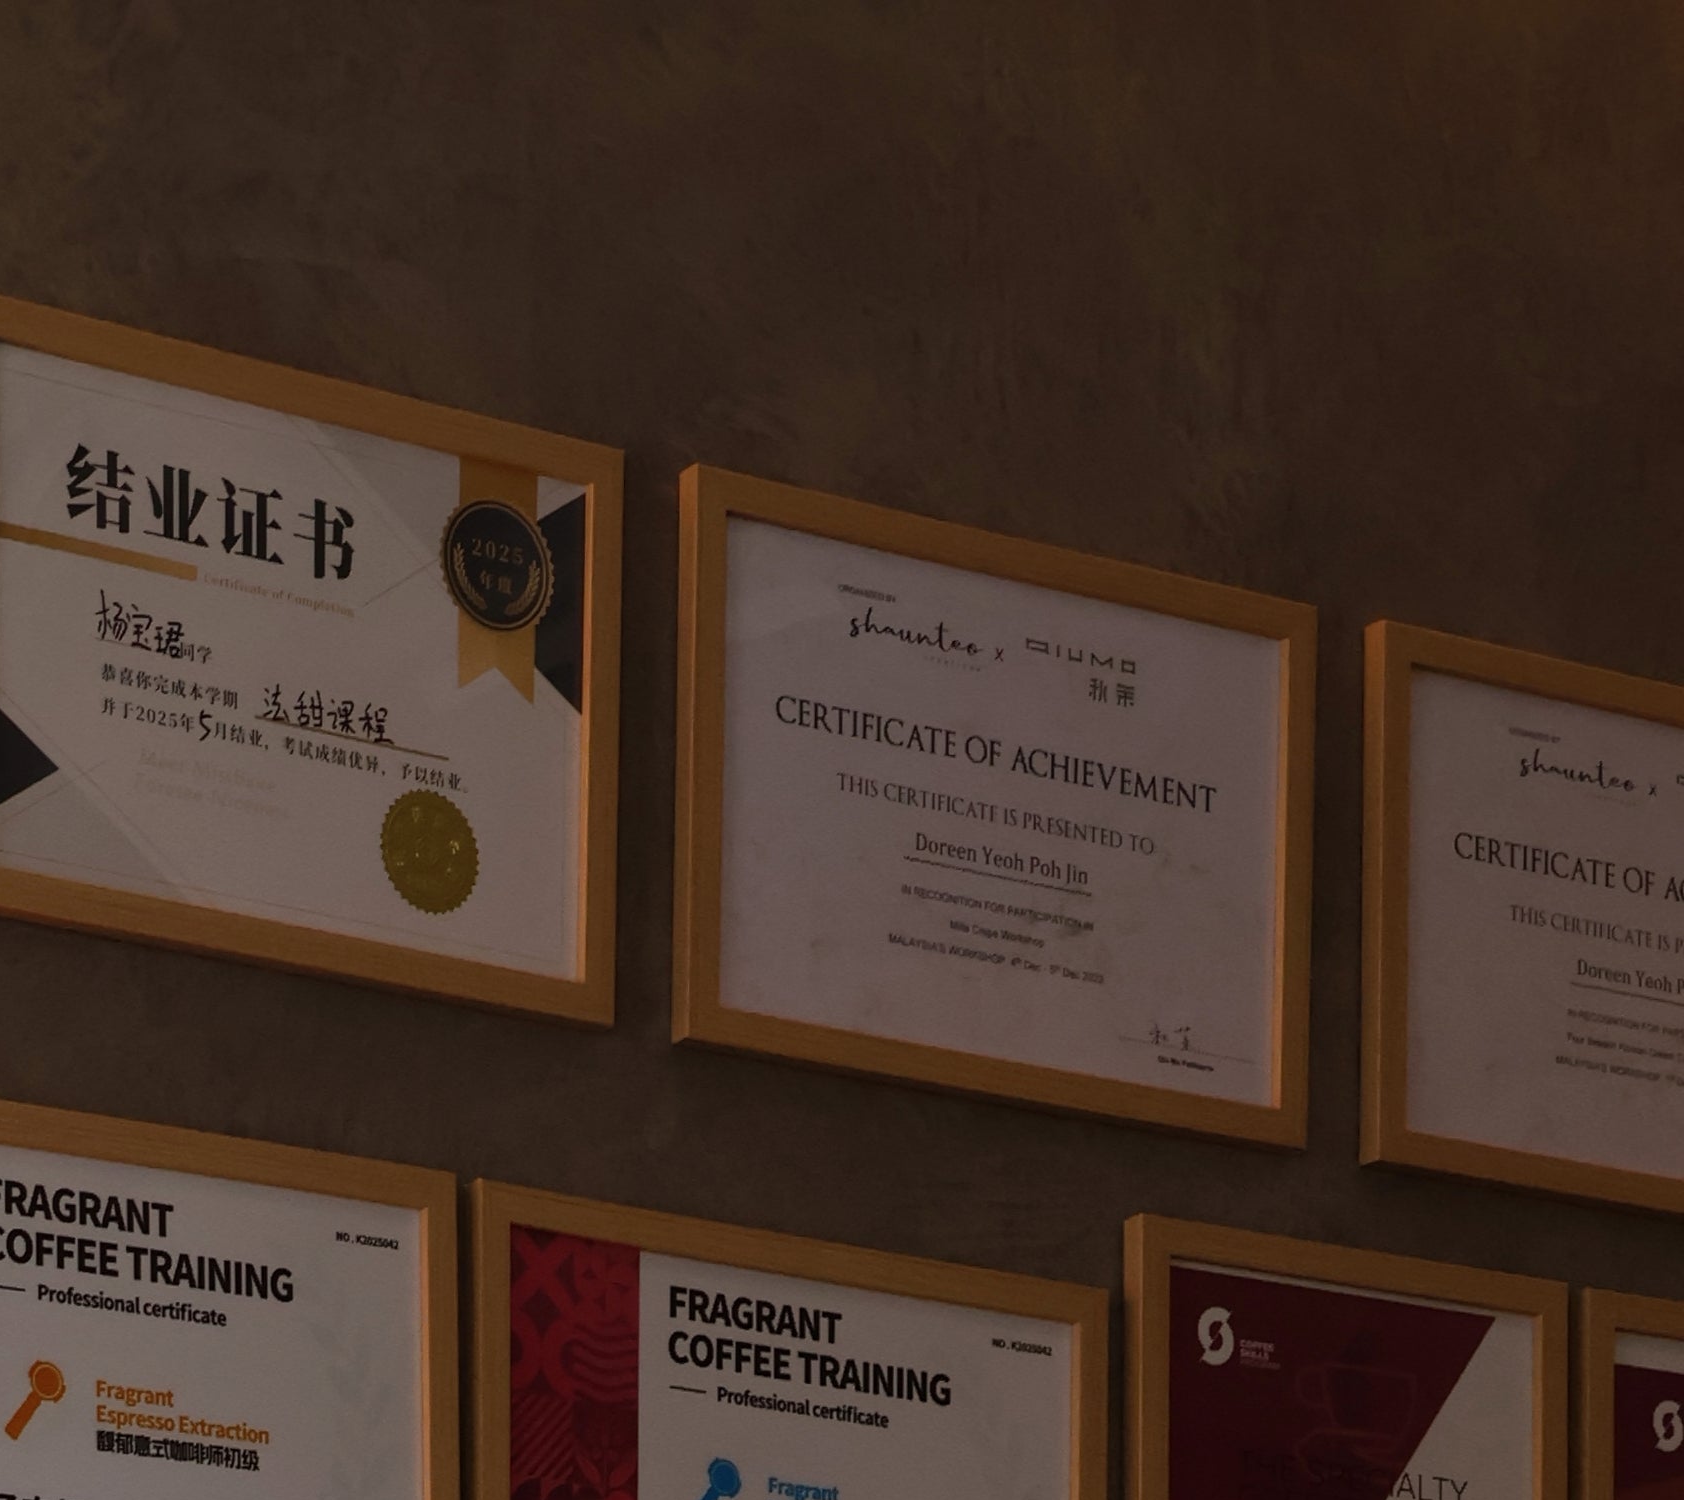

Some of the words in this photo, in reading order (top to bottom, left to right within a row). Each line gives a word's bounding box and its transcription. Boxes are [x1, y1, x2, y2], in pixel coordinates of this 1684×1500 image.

[66, 443, 354, 580] 结业证书
[472, 539, 523, 565] 2025
[203, 573, 268, 599] Certificate
[271, 588, 285, 600] of
[288, 591, 355, 618] Completion
[480, 569, 512, 594] 年度
[100, 663, 239, 710] 恭喜你完成本学期
[261, 684, 395, 747] 法甜课程
[775, 695, 957, 759] CERTIFICATE
[964, 735, 1002, 767] OF
[1010, 745, 1218, 814] ACHIEVEMENT
[836, 772, 879, 798] THIS
[883, 783, 997, 823] CERTIFICATE
[1003, 808, 1017, 827] IS
[1022, 812, 1123, 850] PRESENTED
[1128, 832, 1156, 856] TO
[915, 832, 977, 863] Doreen
[982, 847, 1024, 874] Yeoh
[1029, 855, 1061, 880] Poh
[1066, 863, 1089, 885] Jin
[1453, 831, 1616, 889] CERTIFICATE
[1622, 866, 1656, 896] OF
[1510, 904, 1547, 928] THIS
[1550, 912, 1652, 949] CERTIFICATE
[1657, 933, 1671, 952] IS
[1577, 958, 1631, 985] Doreen
[1635, 970, 1673, 994] Yeoh
[125, 1245, 295, 1303] TRAINING
[36, 1283, 141, 1316] Professional
[142, 1299, 227, 1328] certificate
[668, 1285, 843, 1343] FRAGRANT
[667, 1330, 792, 1381] COFFEE
[797, 1350, 952, 1407] TRAINING
[95, 1380, 175, 1408] Fragrant
[716, 1386, 810, 1417] Professional
[811, 1400, 890, 1429] certificate
[95, 1405, 175, 1431] Espresso
[178, 1416, 270, 1445] Extraction
